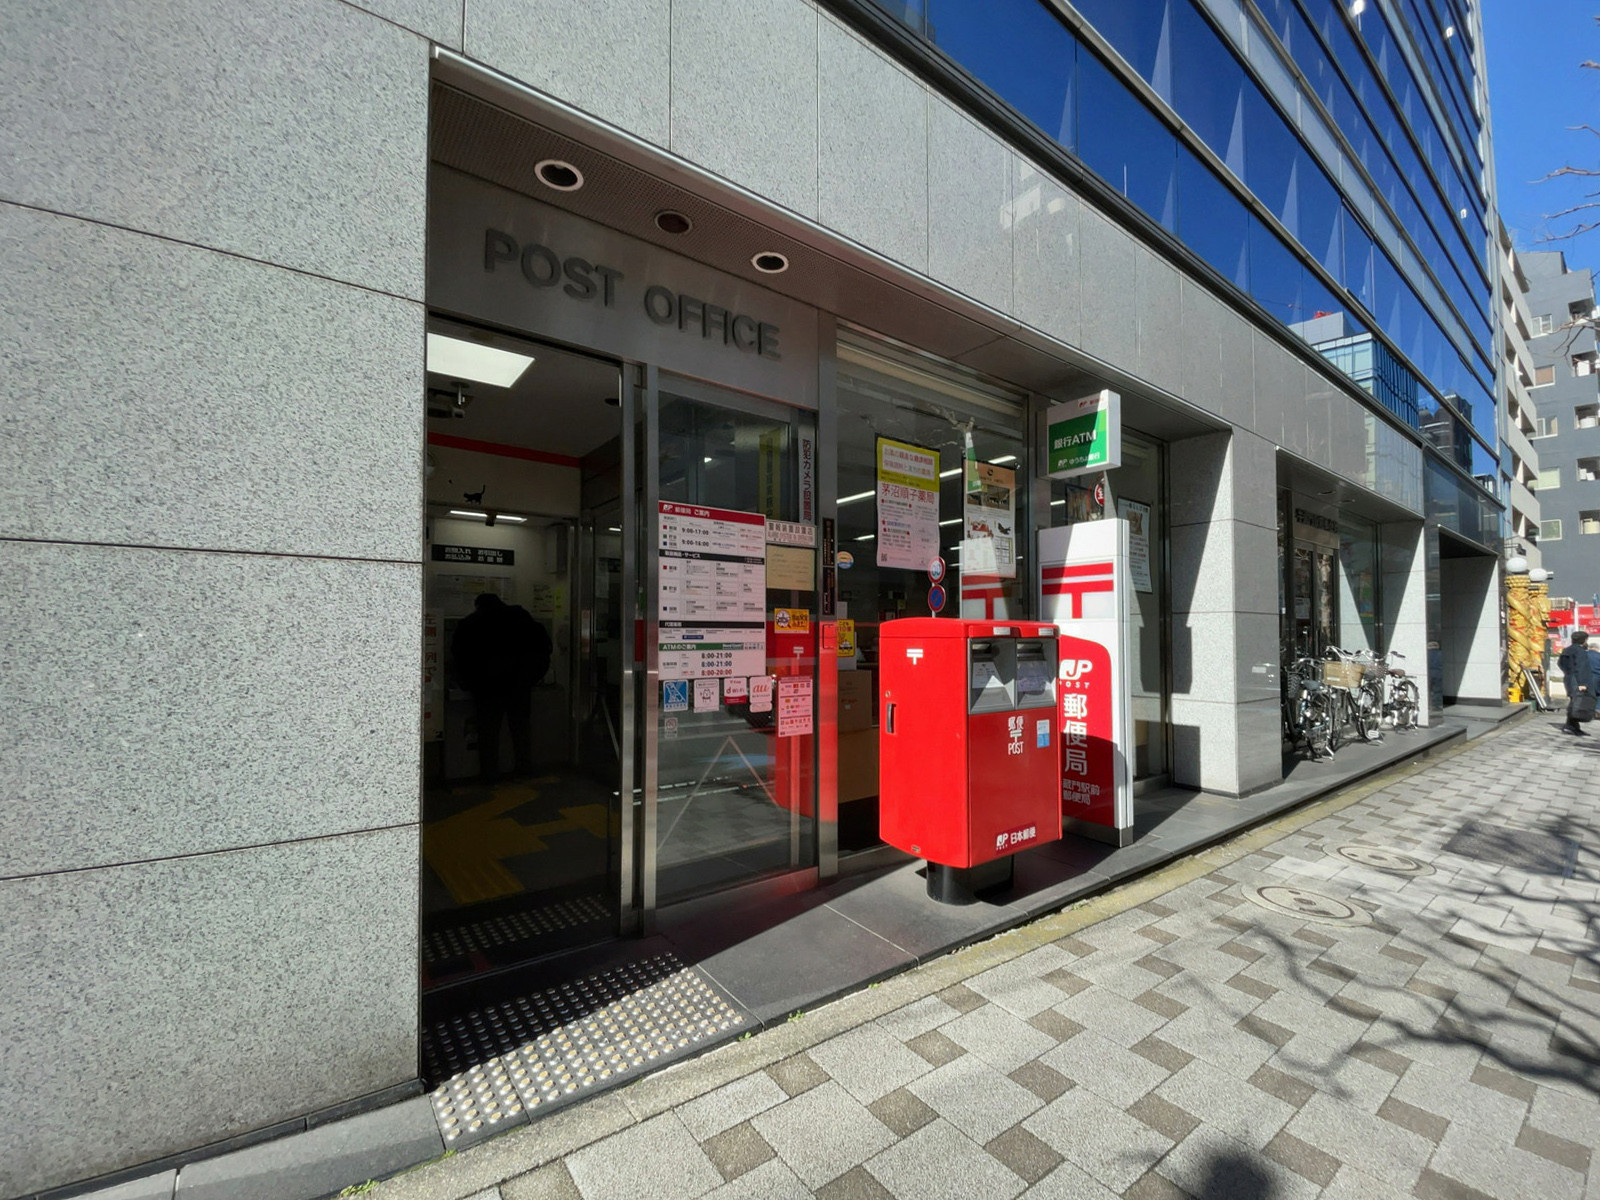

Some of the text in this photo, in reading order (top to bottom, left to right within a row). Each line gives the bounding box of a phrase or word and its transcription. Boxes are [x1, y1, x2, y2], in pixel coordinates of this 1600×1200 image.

[484, 229, 782, 360] POST OFFICE
[1054, 429, 1097, 450] 銀行ATM
[682, 527, 709, 536] 9:00-17:00
[682, 539, 709, 548] 9:00-16:00
[701, 660, 732, 668] 8:00-21:00
[1059, 659, 1093, 680] JP
[752, 684, 768, 693] au
[1008, 716, 1024, 731] 郵便
[1062, 693, 1088, 776] 郵便局
[1008, 741, 1024, 755] POST
[1062, 789, 1091, 806] 郵便局
[1010, 826, 1036, 845] 日本郵便
